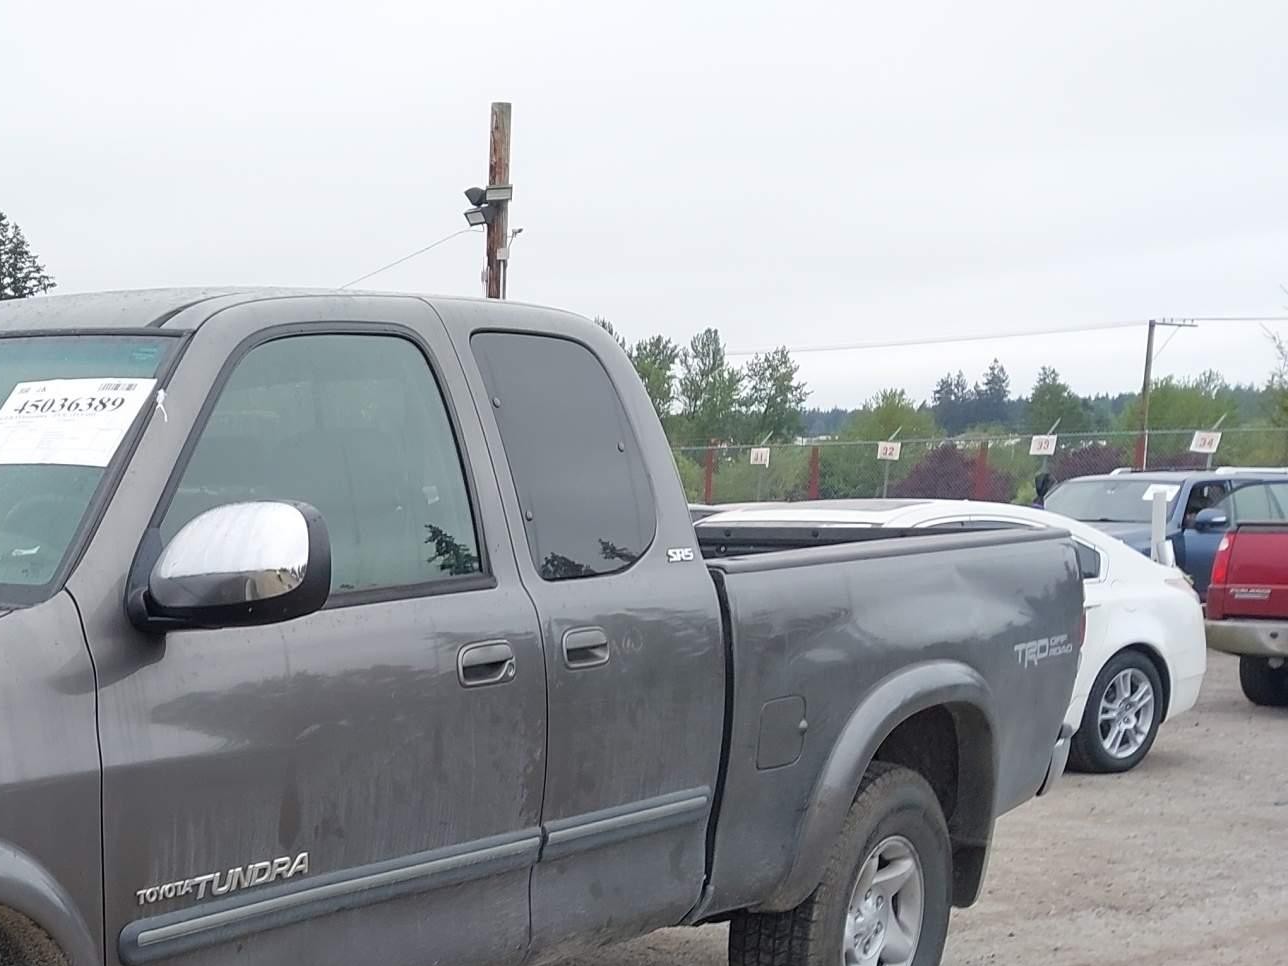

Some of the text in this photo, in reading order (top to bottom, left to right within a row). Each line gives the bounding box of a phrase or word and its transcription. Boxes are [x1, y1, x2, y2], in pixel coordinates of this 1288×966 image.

[13, 397, 125, 415] 45036389
[1014, 638, 1049, 669] TRD
[1048, 644, 1073, 657] ROAD
[136, 852, 309, 905] TOYOTA TUNDRA
